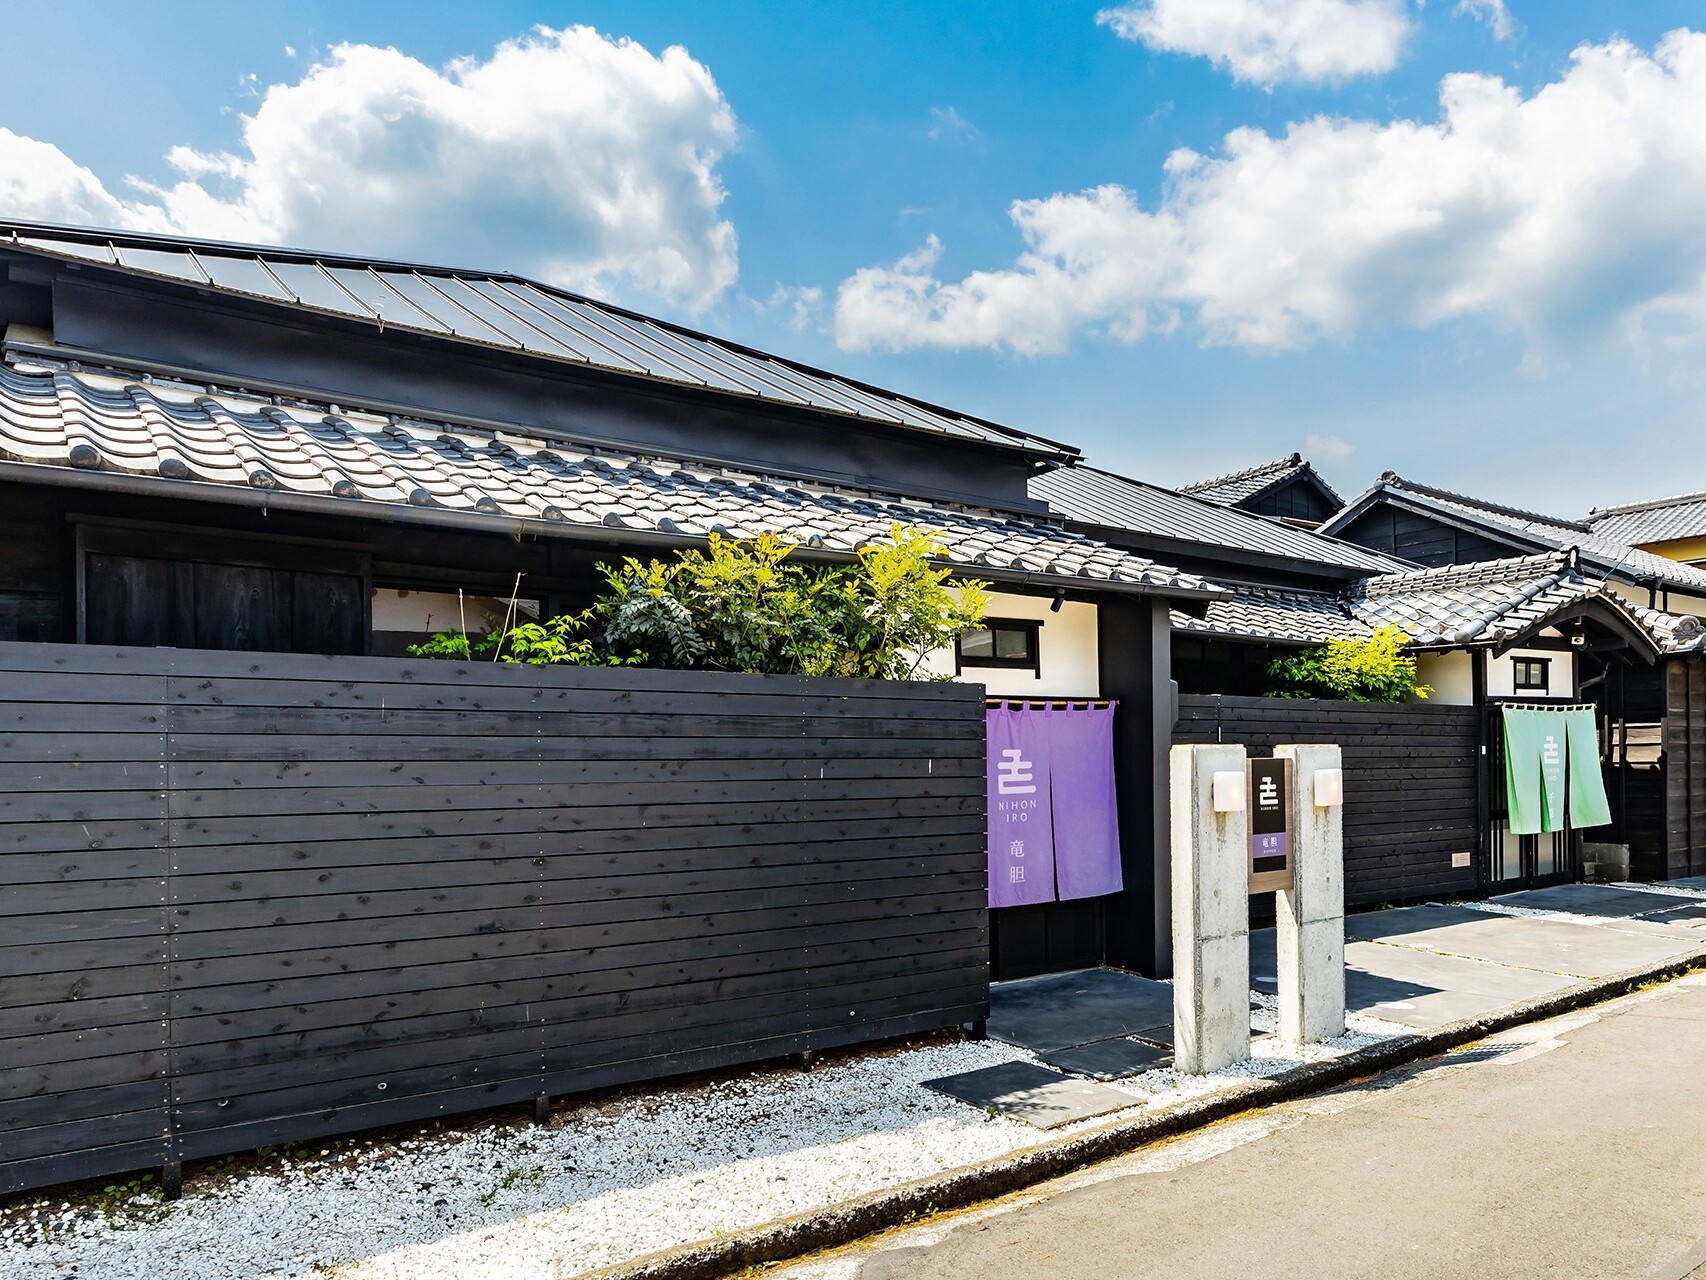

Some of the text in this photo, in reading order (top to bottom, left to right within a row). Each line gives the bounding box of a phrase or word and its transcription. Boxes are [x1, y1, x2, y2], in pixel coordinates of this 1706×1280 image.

[999, 800, 1036, 810] NIHON
[1006, 812, 1028, 823] IRO
[1010, 840, 1025, 883] 竜胆
